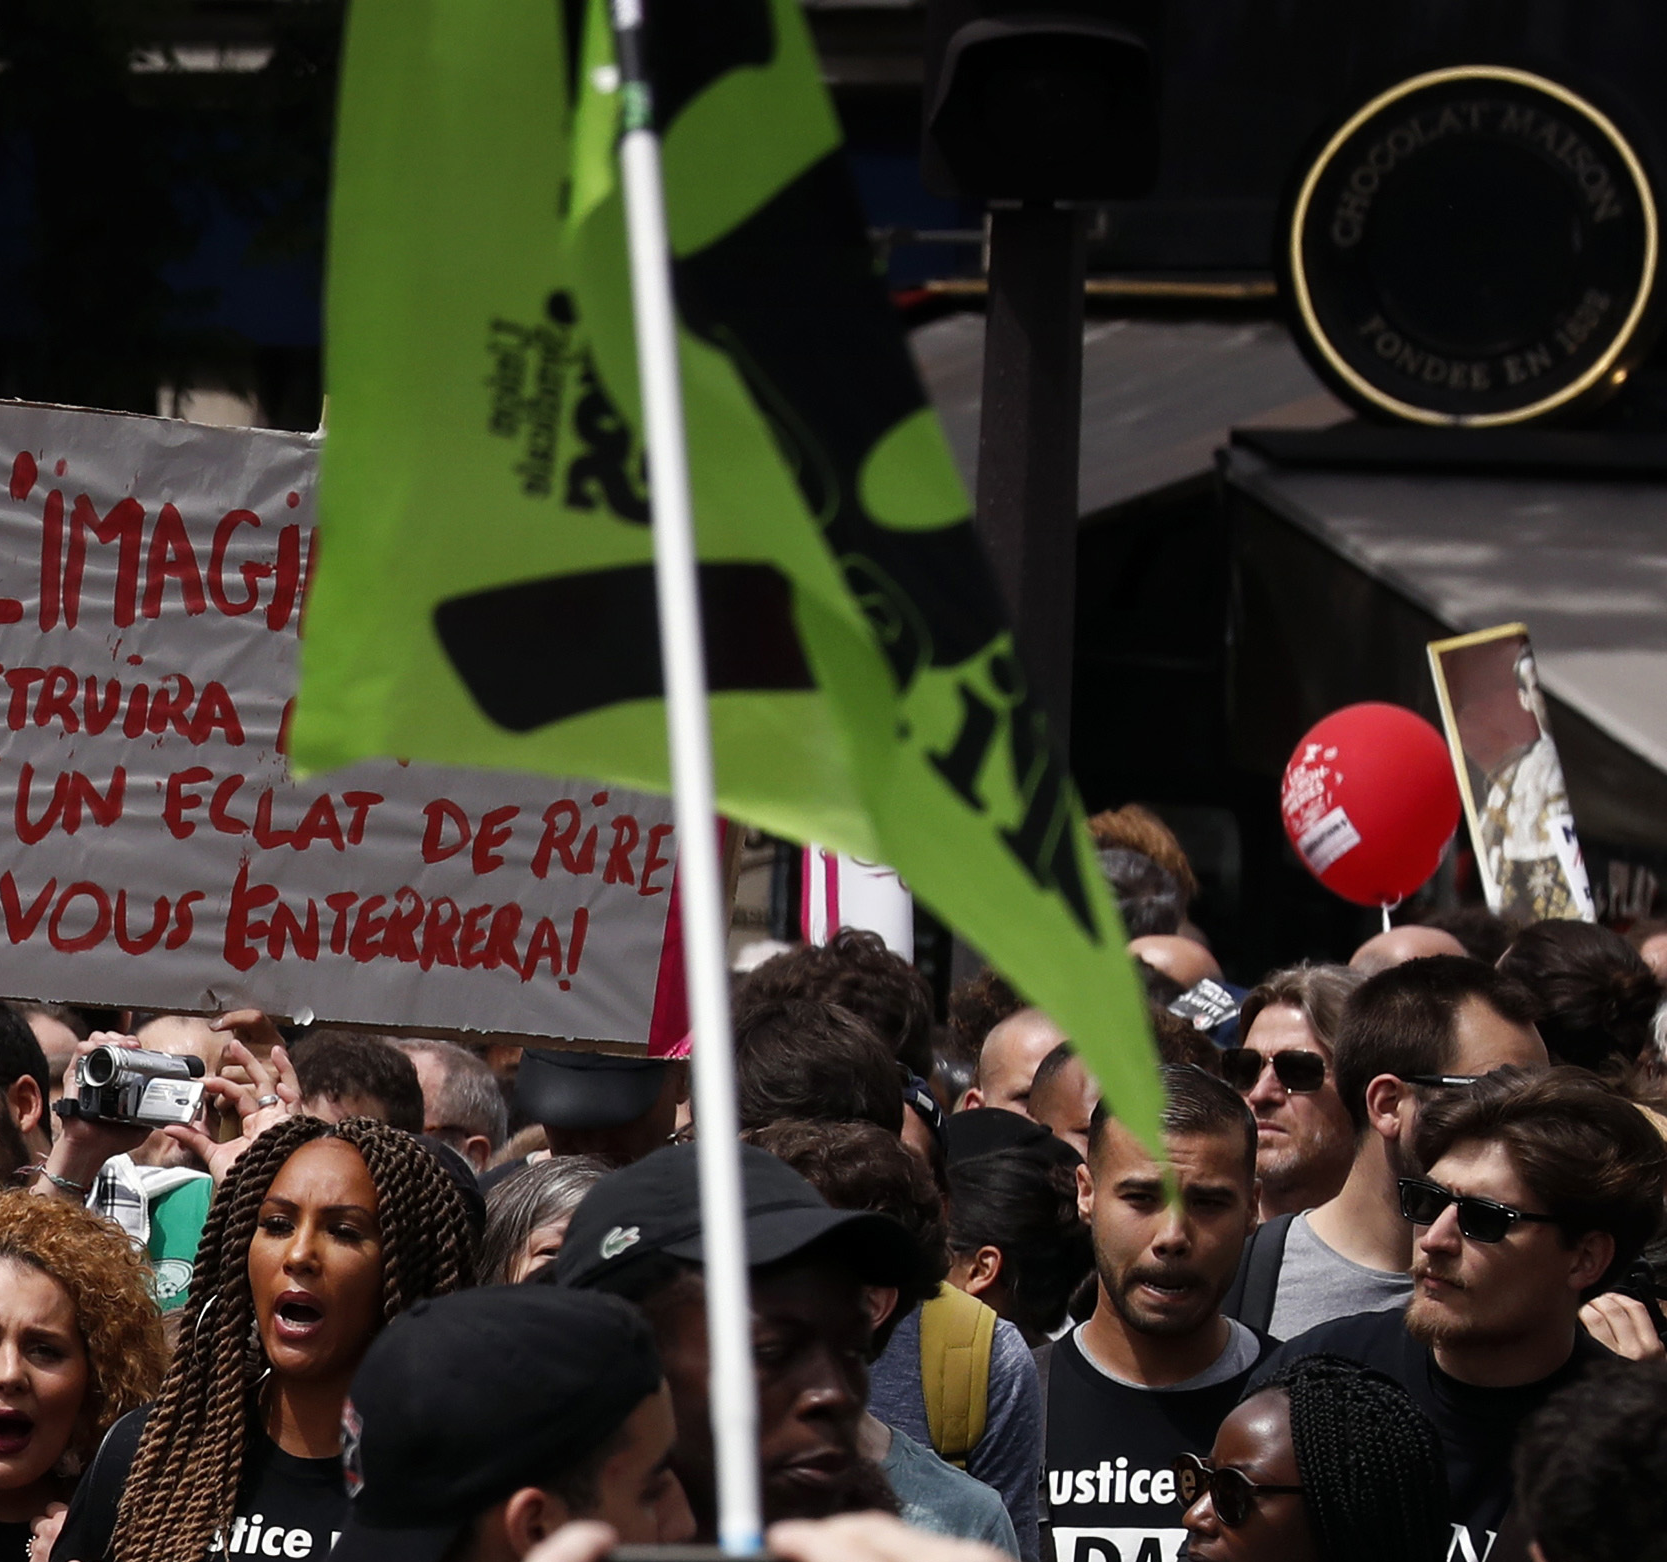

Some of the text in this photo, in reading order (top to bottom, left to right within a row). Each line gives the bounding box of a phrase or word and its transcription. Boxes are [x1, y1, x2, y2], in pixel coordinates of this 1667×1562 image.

[15, 762, 126, 844] UN
[164, 766, 385, 851] ECLAT
[422, 798, 520, 875] DE
[0, 870, 206, 955] VOUS
[1049, 1456, 1177, 1506] ustice
